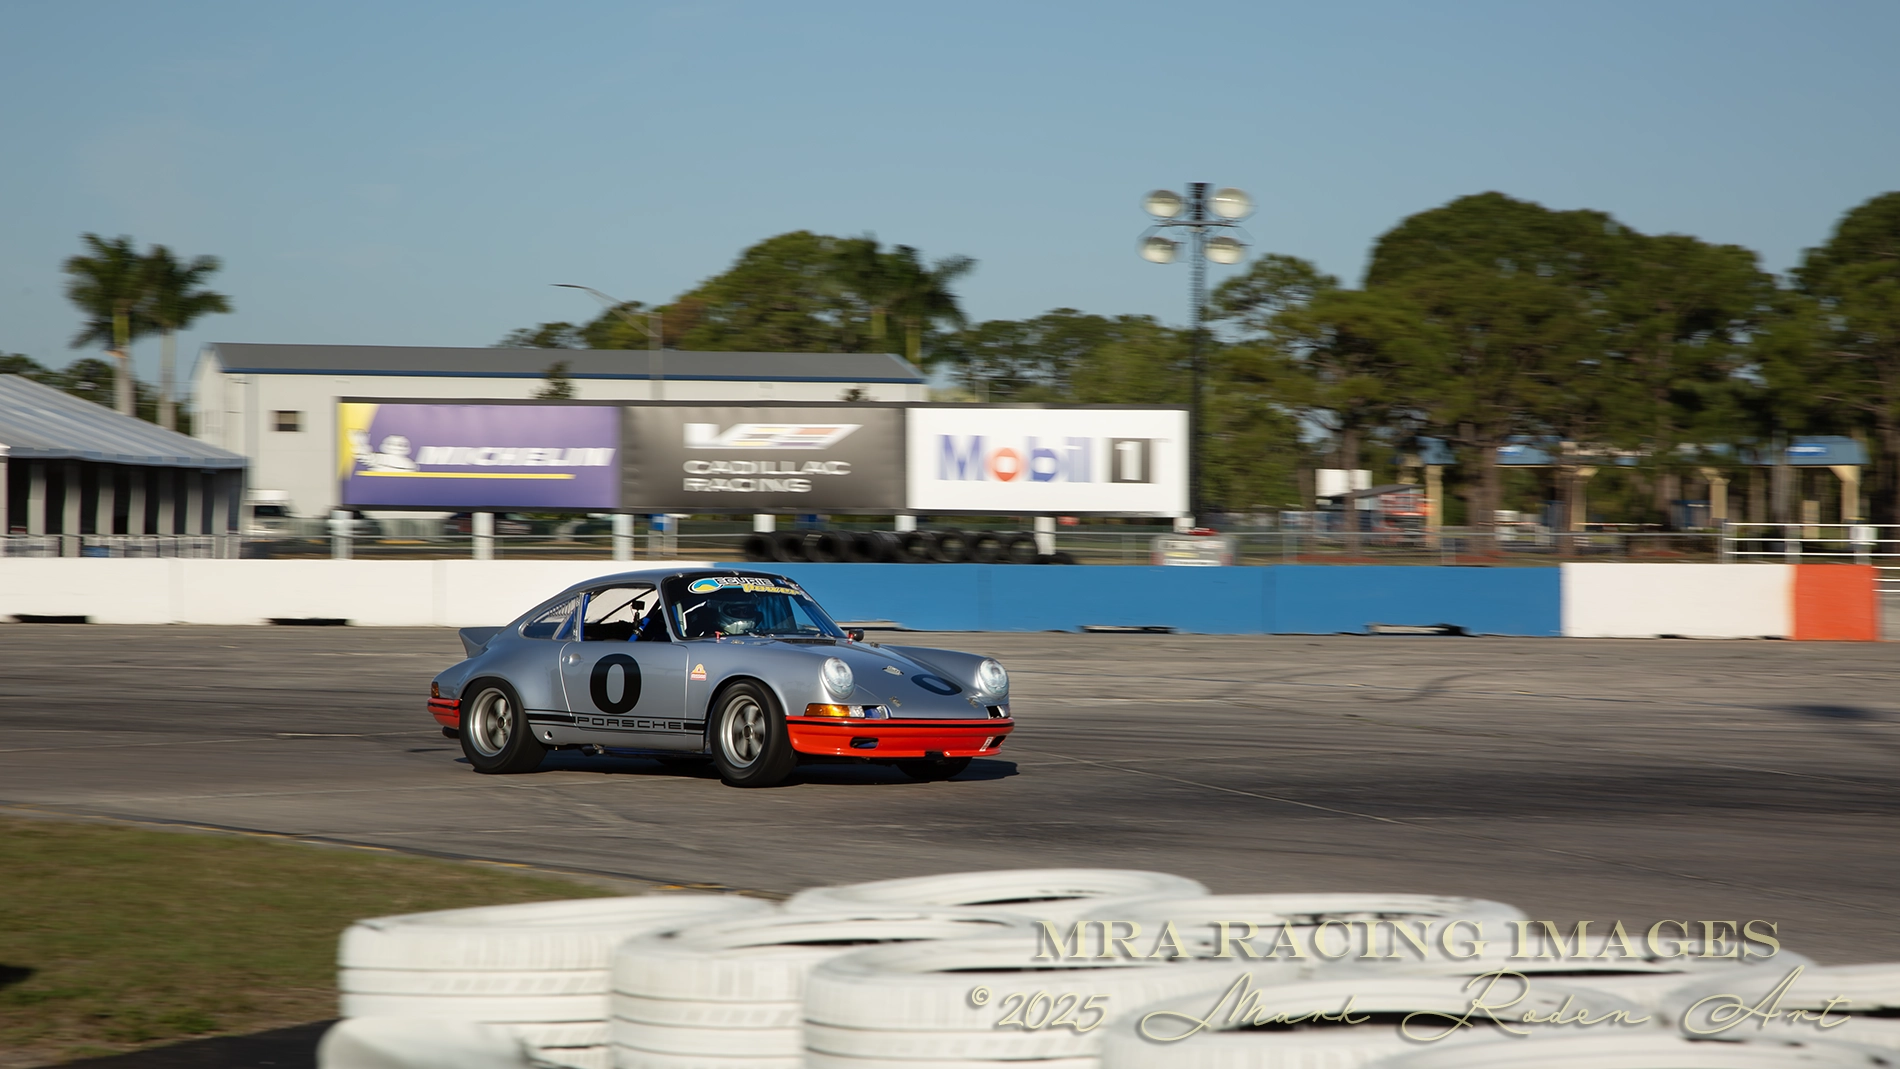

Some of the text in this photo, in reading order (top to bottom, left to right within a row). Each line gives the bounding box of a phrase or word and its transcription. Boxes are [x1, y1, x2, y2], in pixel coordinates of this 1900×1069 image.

[416, 446, 616, 466] MICHELIN
[936, 434, 1094, 483] Mobil
[683, 460, 852, 475] CADILLAC
[683, 478, 812, 493] RACING
[590, 653, 642, 714] 0
[911, 674, 962, 696] 0
[577, 716, 683, 730] PORSCHE
